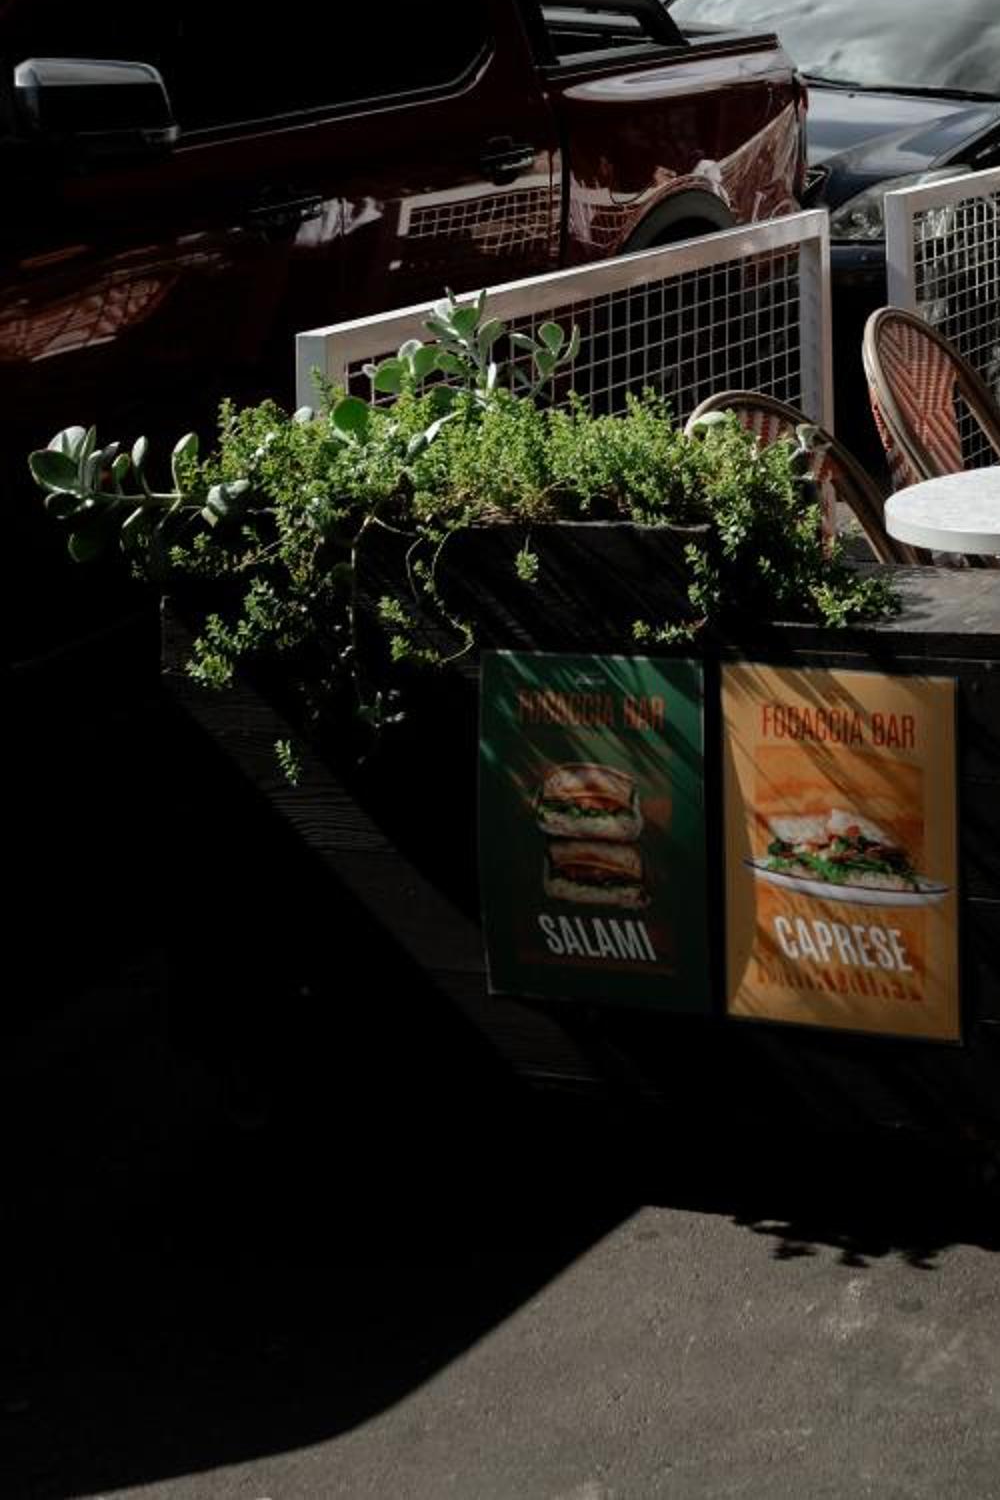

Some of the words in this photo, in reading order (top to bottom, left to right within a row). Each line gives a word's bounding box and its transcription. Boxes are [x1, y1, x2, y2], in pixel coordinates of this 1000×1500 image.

[871, 712, 916, 749] BAR
[538, 913, 658, 962] SALAMI
[773, 914, 915, 972] CAPRESE
